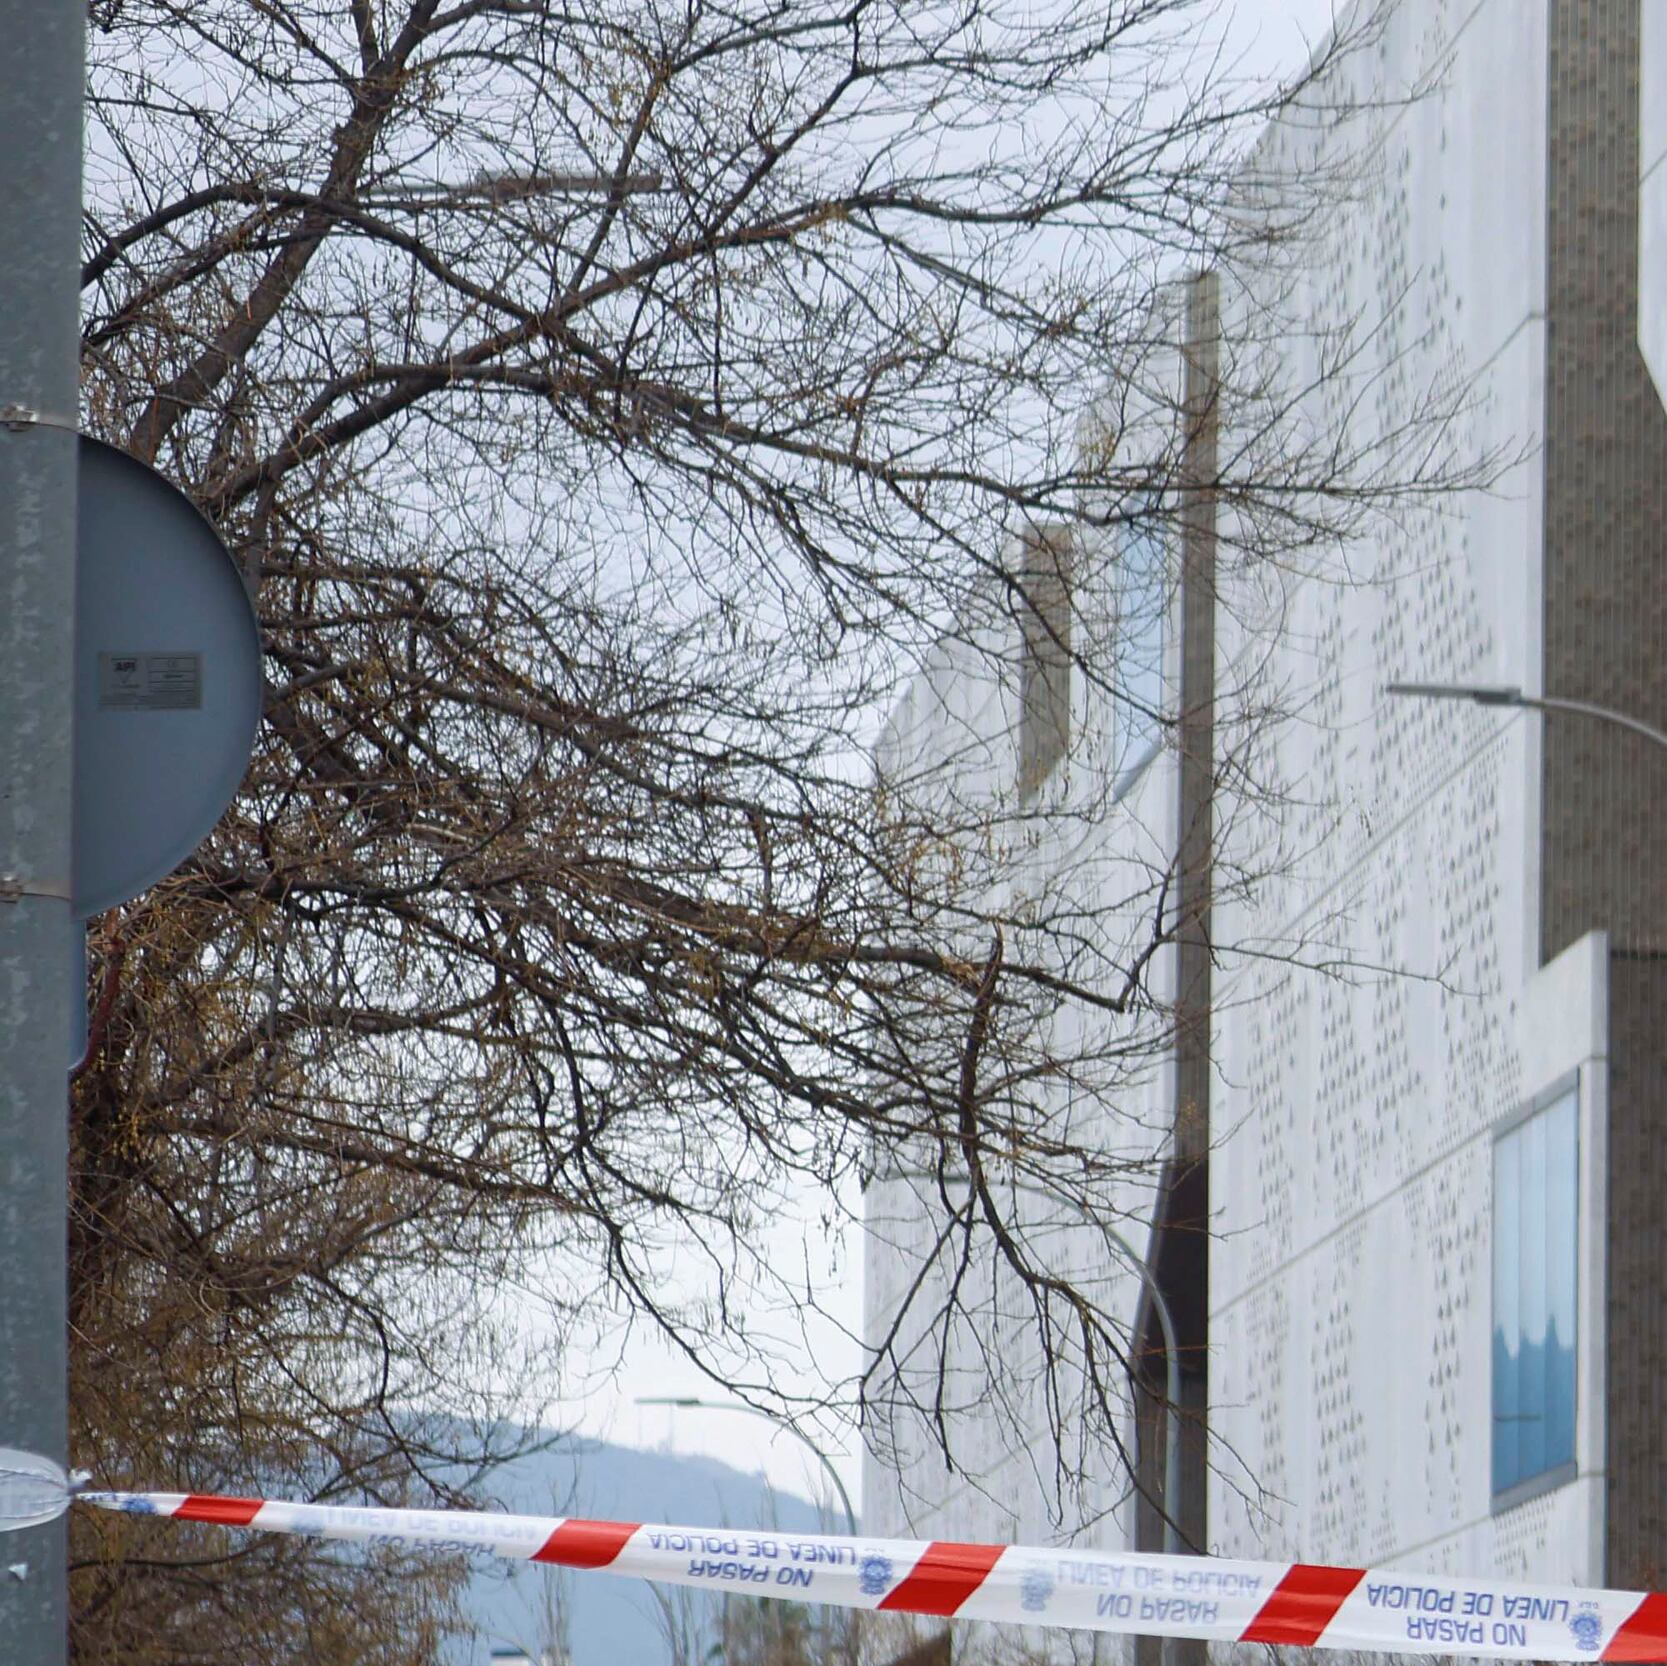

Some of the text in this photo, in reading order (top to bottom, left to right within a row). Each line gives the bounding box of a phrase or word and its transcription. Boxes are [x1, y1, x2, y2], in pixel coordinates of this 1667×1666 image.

[649, 1533, 856, 1565] LINEA DE POLICIA
[688, 1558, 813, 1588] NO PASAR
[1367, 1584, 1569, 1622] LINEA DE POLICIA
[1406, 1616, 1526, 1647] NO PASAR
